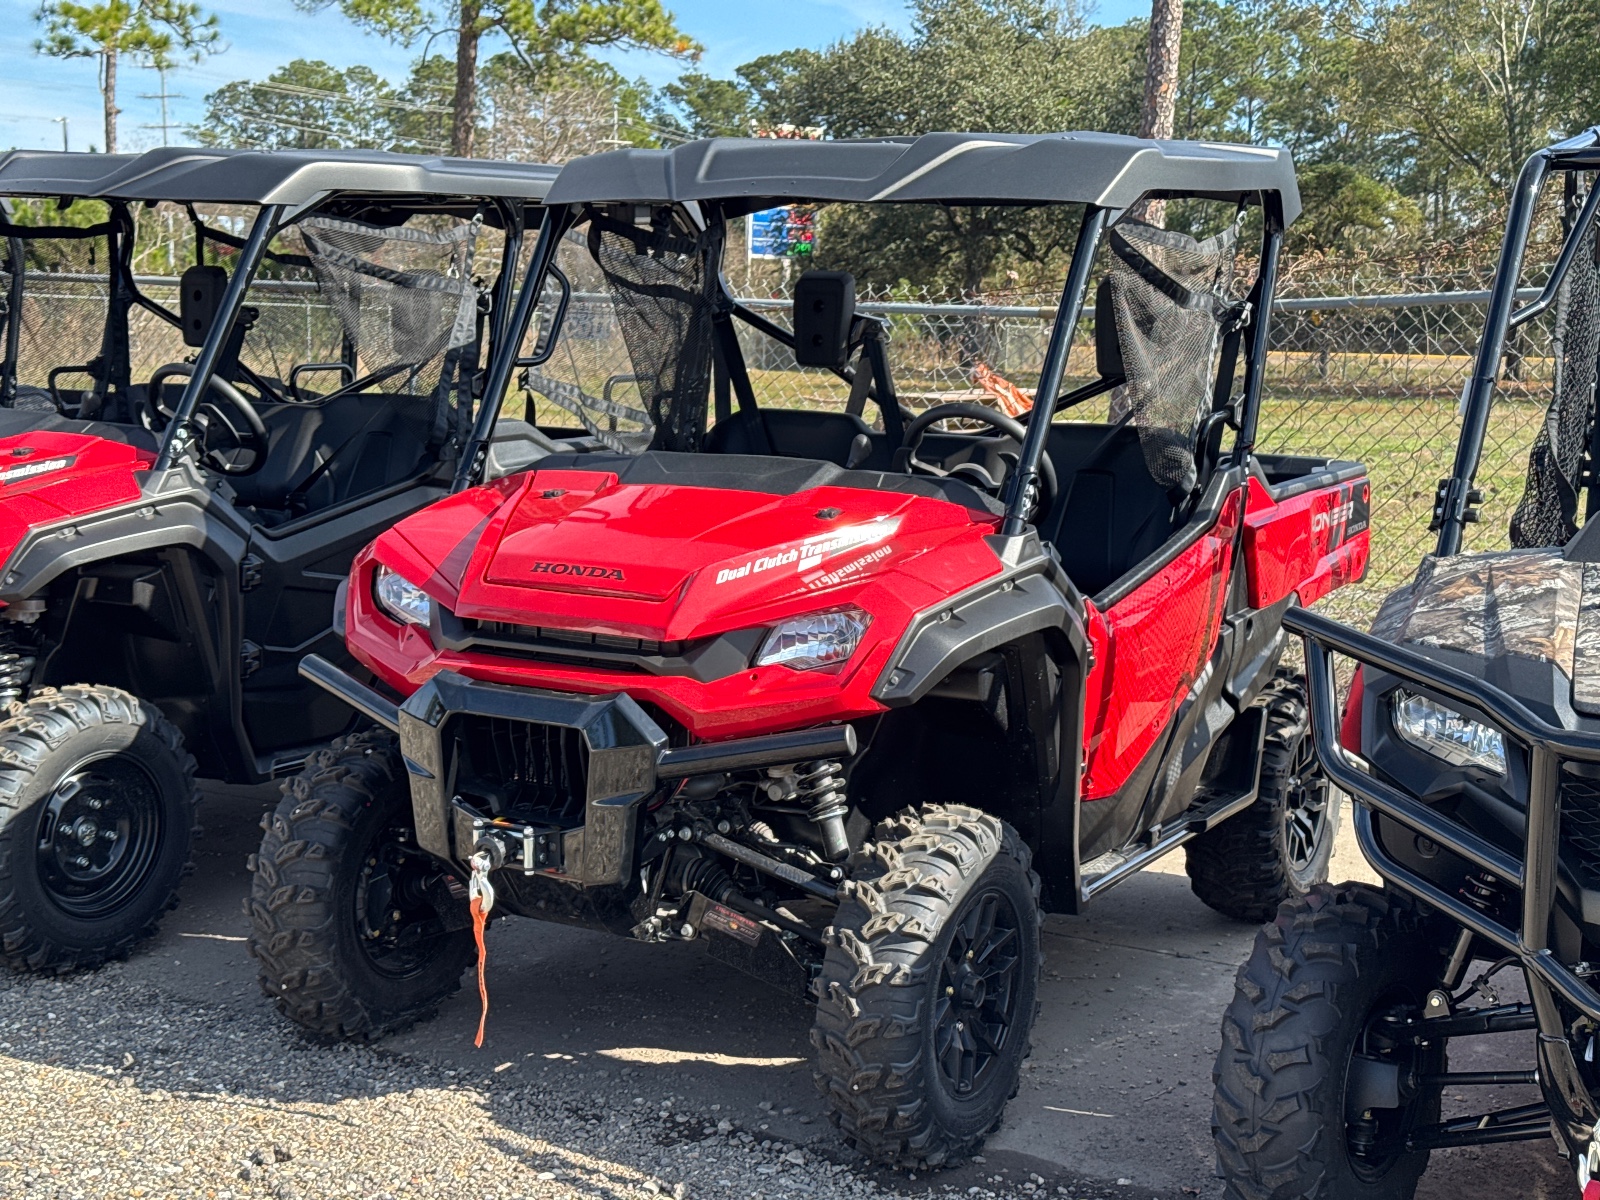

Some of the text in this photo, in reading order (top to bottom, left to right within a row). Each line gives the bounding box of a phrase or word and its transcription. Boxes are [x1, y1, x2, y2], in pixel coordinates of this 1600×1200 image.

[1347, 520, 1366, 536] HONDA
[716, 524, 891, 584] Dual Clutch Transm
[530, 561, 625, 580] HONDA
